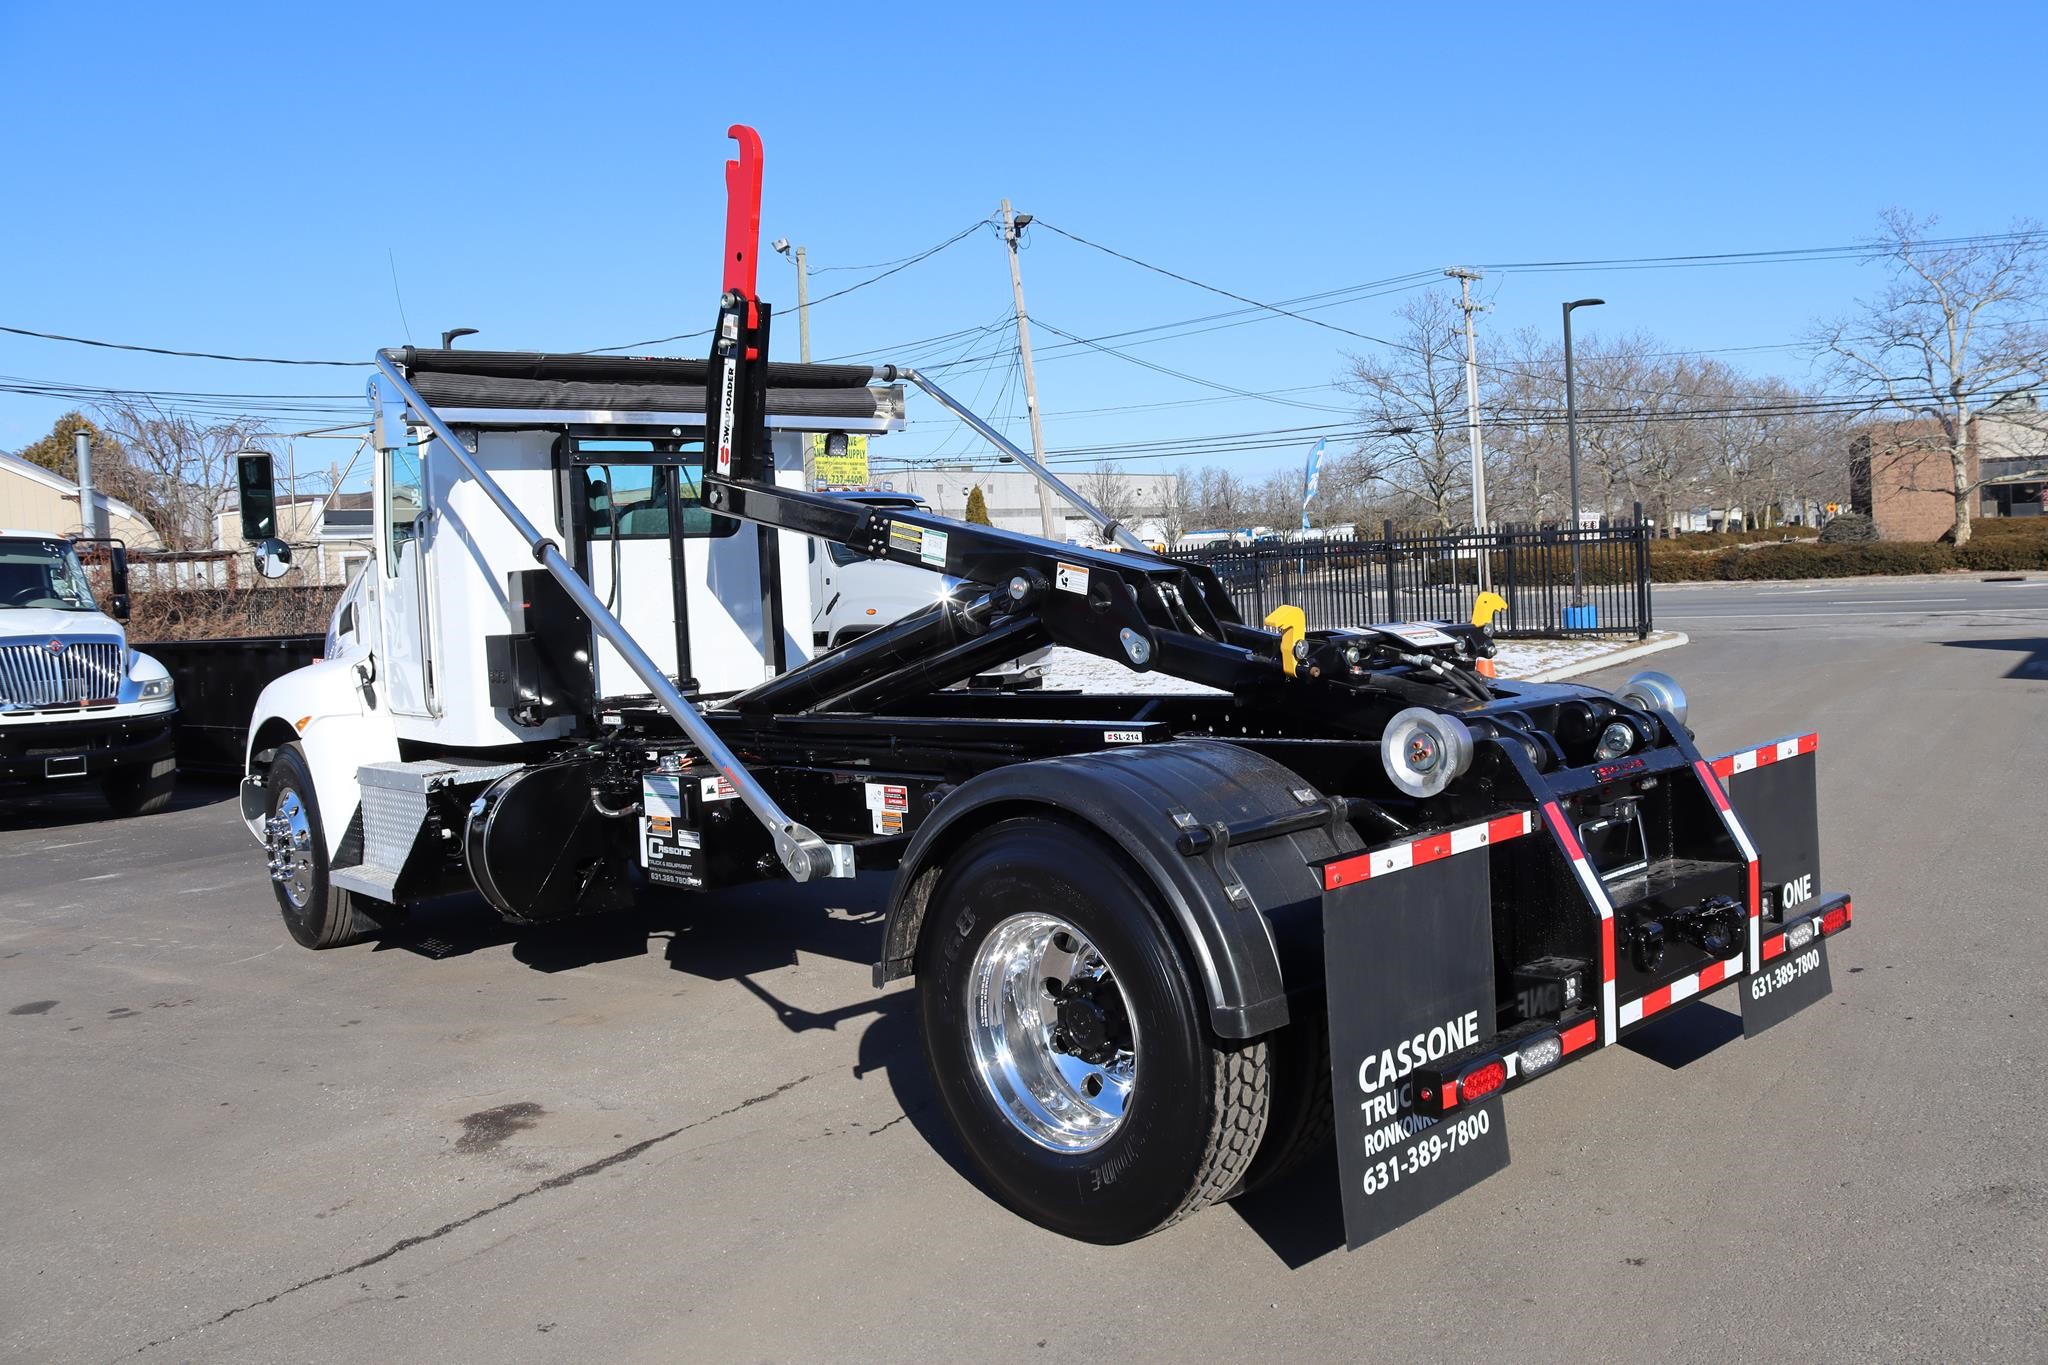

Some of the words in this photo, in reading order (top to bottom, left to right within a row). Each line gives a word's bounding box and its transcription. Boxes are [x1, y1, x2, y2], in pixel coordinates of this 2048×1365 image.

[723, 367, 734, 444] SWAPLOADER
[1113, 733, 1139, 741] SL-214
[649, 837, 691, 859] CASSONE
[1781, 873, 1812, 909] ONE
[1752, 948, 1820, 1000] 631-389-7800
[1359, 1009, 1480, 1094] CASSONE
[1361, 1082, 1413, 1126] TRUC
[1363, 1109, 1490, 1195] 631-389-7800
